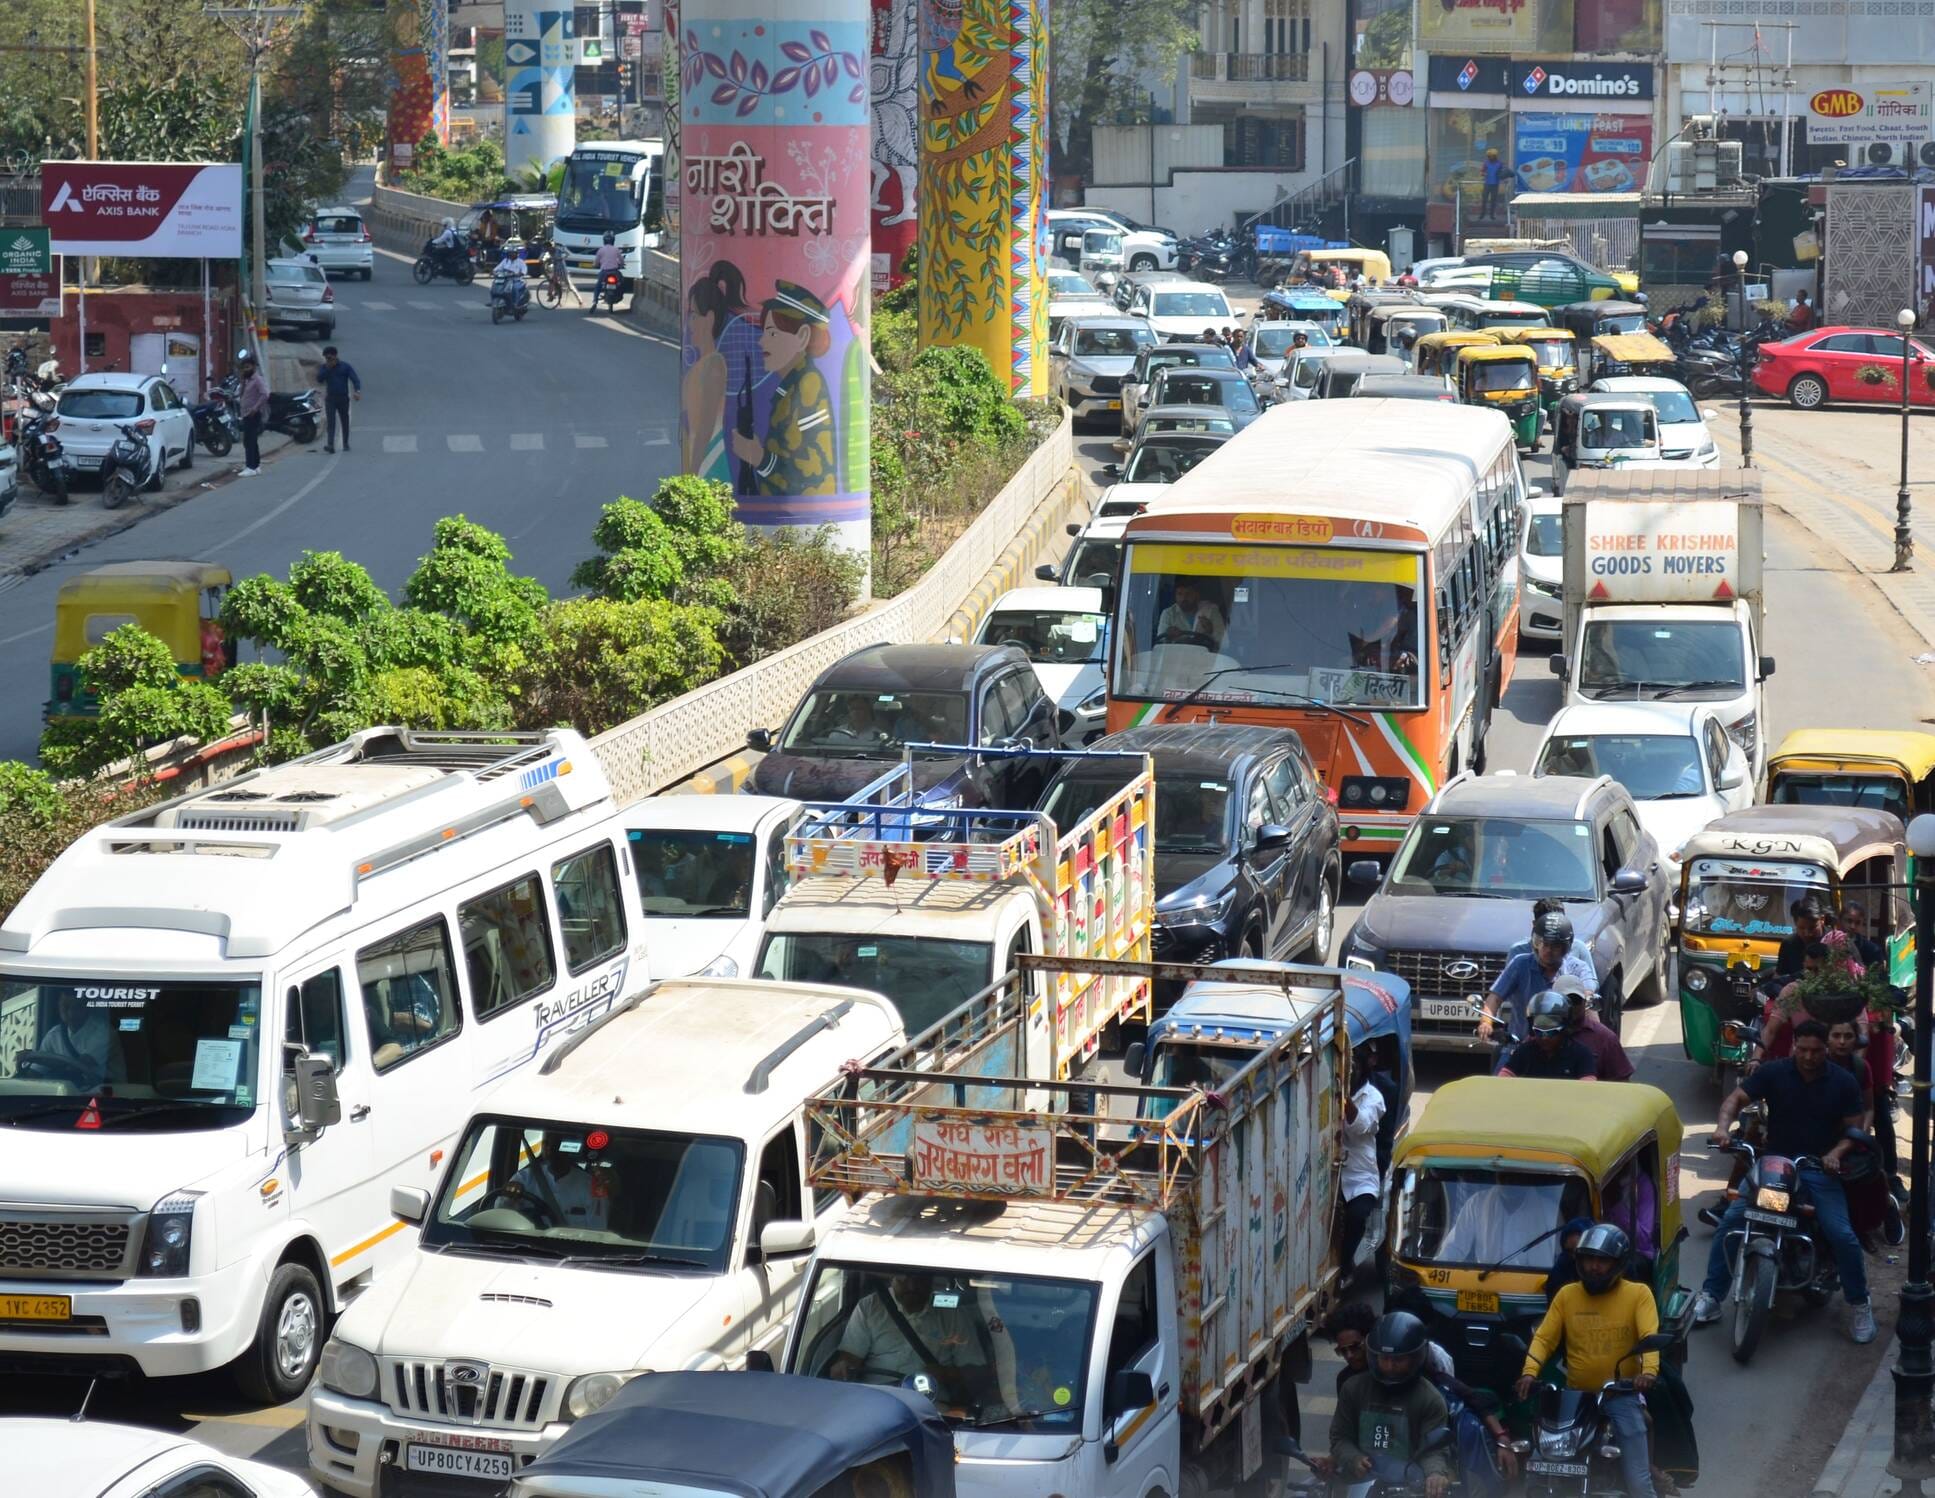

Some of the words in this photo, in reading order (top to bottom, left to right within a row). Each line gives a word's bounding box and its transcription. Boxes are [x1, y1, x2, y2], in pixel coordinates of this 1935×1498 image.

[1549, 74, 1640, 95] Domino's
[1814, 93, 1860, 114] GMB
[1877, 101, 1917, 116] गोपिका
[1906, 124, 1928, 132] South
[684, 141, 763, 195] नारी
[135, 185, 160, 201] बैंक
[96, 206, 124, 216] AXIS
[126, 206, 160, 216] BANK
[710, 182, 835, 234] शक्ति
[1590, 535, 1646, 550] SHREE
[1656, 535, 1736, 550] KRISHNA
[1592, 556, 1652, 575] GOODS
[1663, 556, 1726, 574] MOVERS
[1722, 839, 1802, 855] KGN
[74, 987, 160, 1000] TOURIST
[1429, 1269, 1451, 1283] 491
[34, 1301, 67, 1316] 4352
[418, 1450, 509, 1476] UP80CY4259
